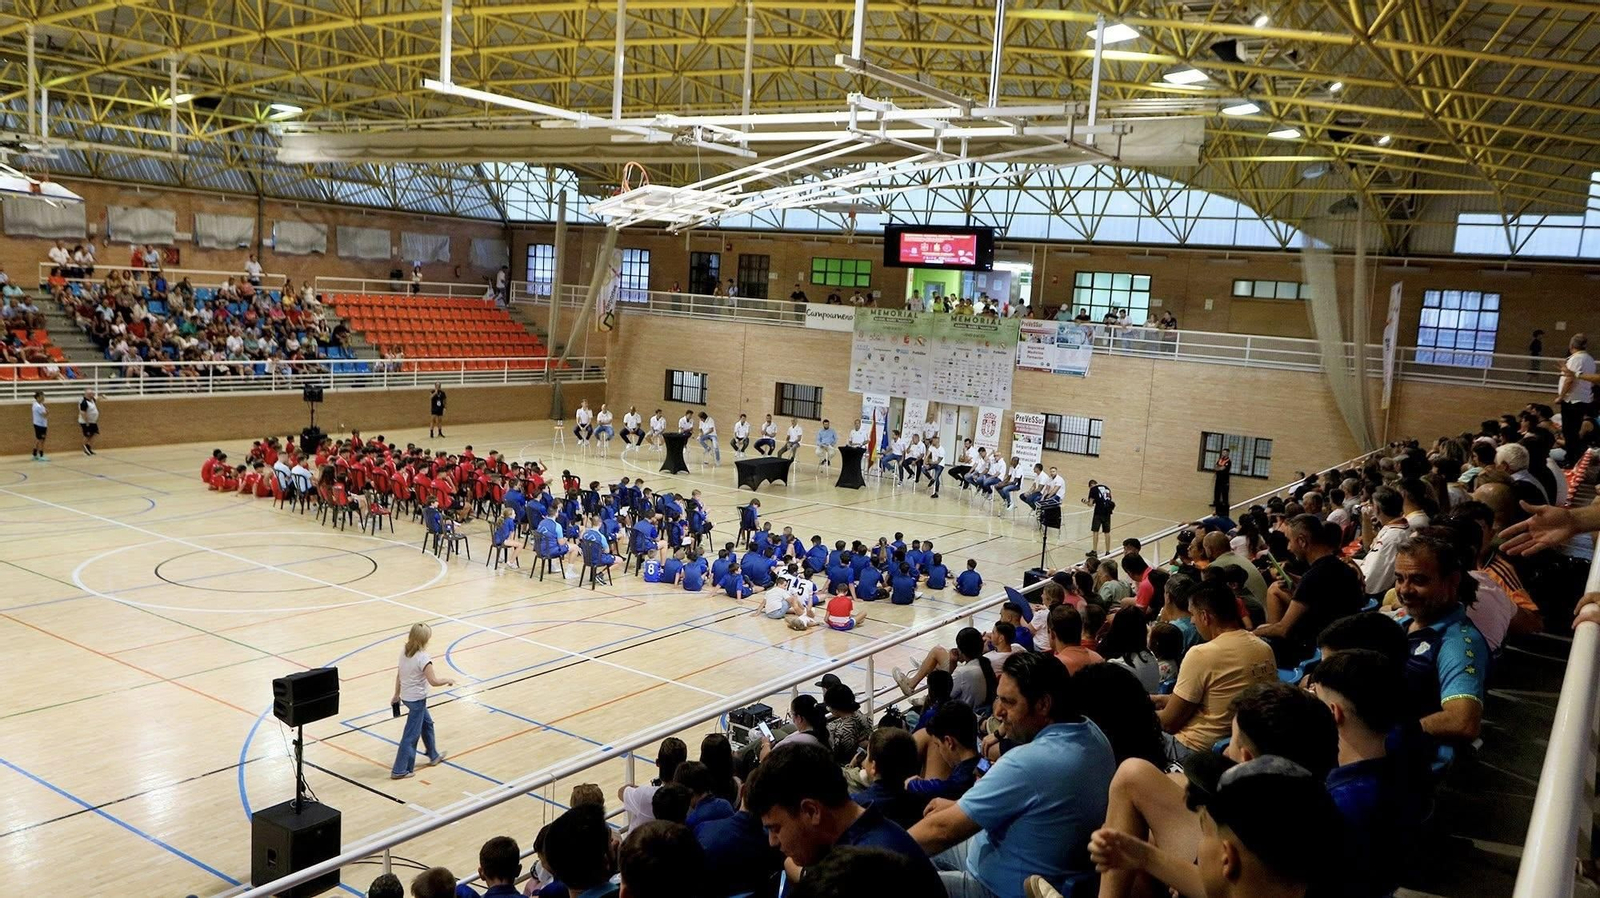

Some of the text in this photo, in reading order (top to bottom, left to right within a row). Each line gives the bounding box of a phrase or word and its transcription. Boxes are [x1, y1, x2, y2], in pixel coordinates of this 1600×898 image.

[870, 309, 918, 319] MEMORIAL
[951, 315, 1002, 326] MEMORIAL
[1015, 413, 1045, 425] PreVeSSur
[1015, 443, 1038, 451] Seguridad
[647, 563, 655, 575] 8
[797, 582, 806, 596] 5
